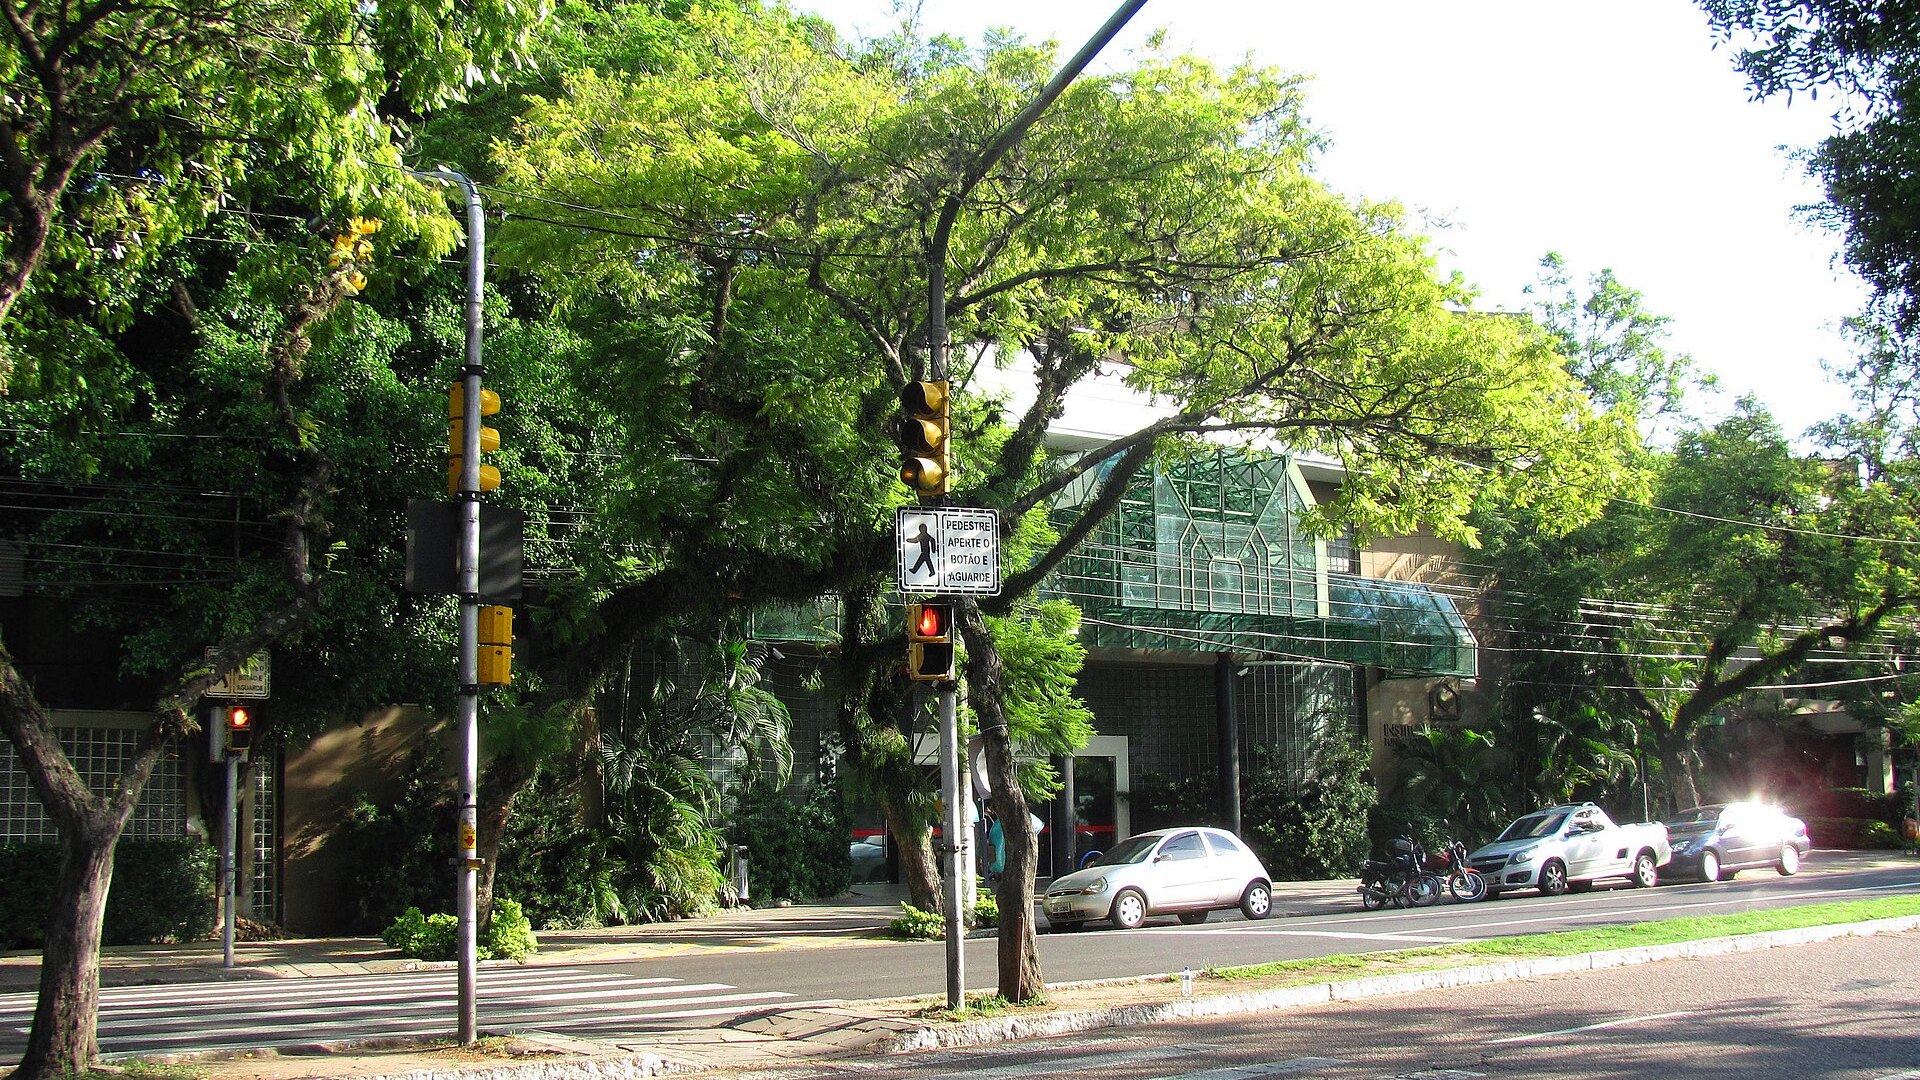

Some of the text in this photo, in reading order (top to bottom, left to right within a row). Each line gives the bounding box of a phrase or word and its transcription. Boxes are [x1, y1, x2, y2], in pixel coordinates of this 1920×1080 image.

[947, 521, 990, 531] PEDESTRE
[948, 537, 989, 547] APERTE O
[951, 553, 988, 565] BOTÃO E
[948, 572, 990, 582] AGUARDE
